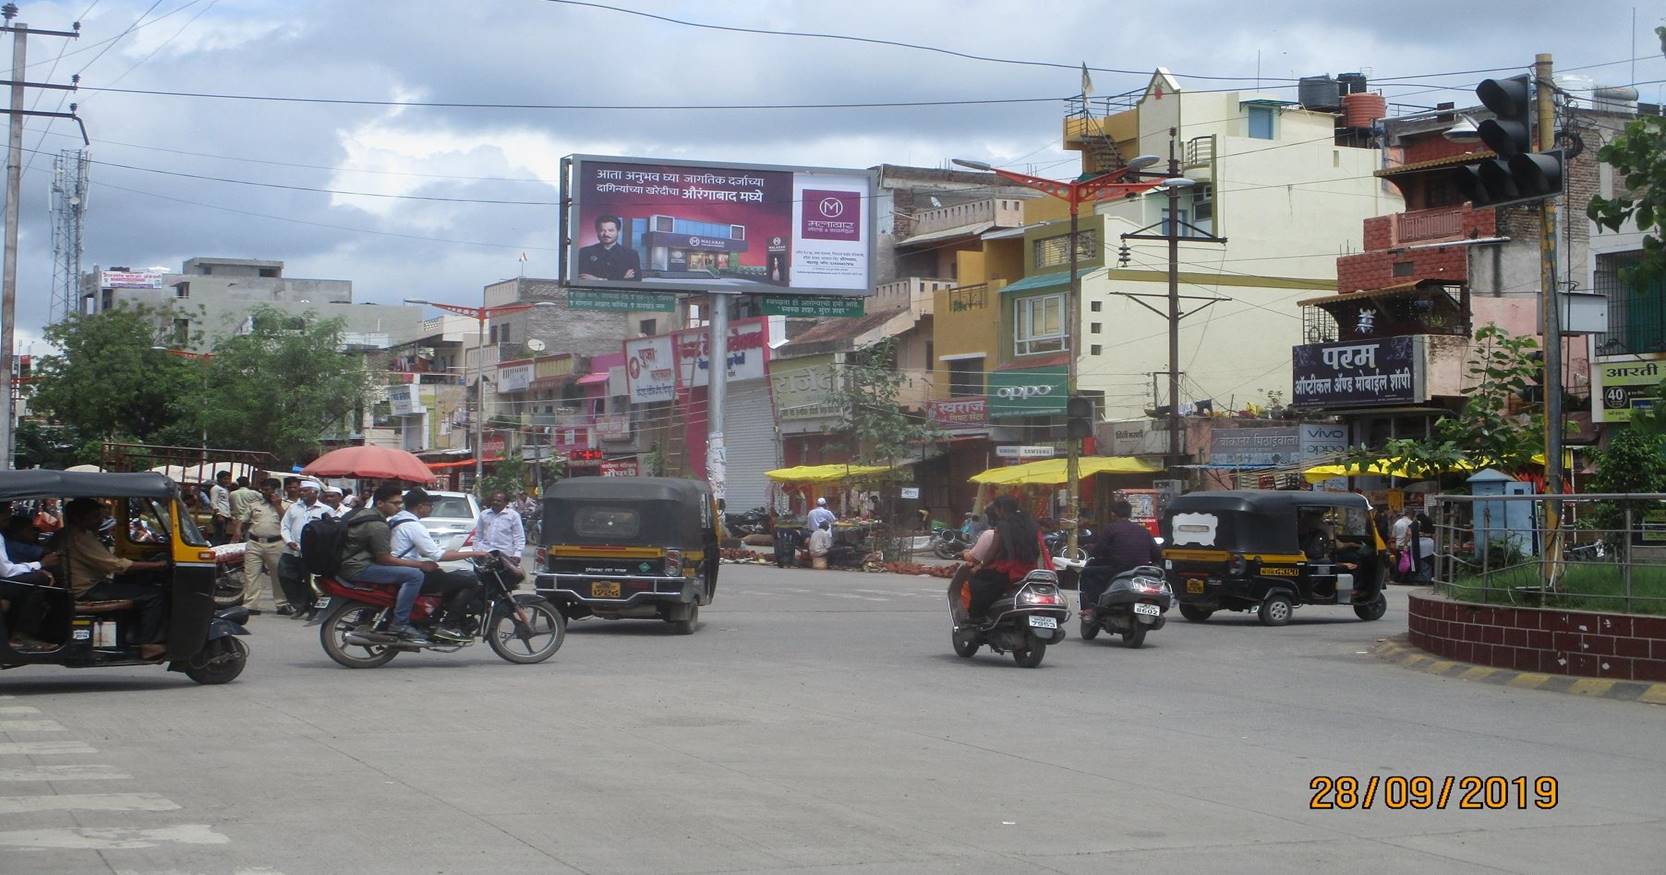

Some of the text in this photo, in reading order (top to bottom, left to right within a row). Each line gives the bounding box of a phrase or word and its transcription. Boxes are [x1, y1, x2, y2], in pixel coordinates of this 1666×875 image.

[597, 169, 764, 187] आता अनुभव घ्या जागतिक दर्जाच्या
[596, 183, 764, 202] दागिन्यांच्या खरेदीचा औरंगाबाद मध्ये
[1321, 344, 1380, 369] परम
[1606, 363, 1658, 377] आरती
[1295, 373, 1331, 395] ऑप्टीकल
[1355, 369, 1387, 394] मोबाईल
[1390, 367, 1411, 391] शॉपी
[997, 385, 1053, 400] oppo
[1608, 389, 1624, 401] 40
[938, 400, 985, 414] स्वराज
[1308, 428, 1344, 438] vivo
